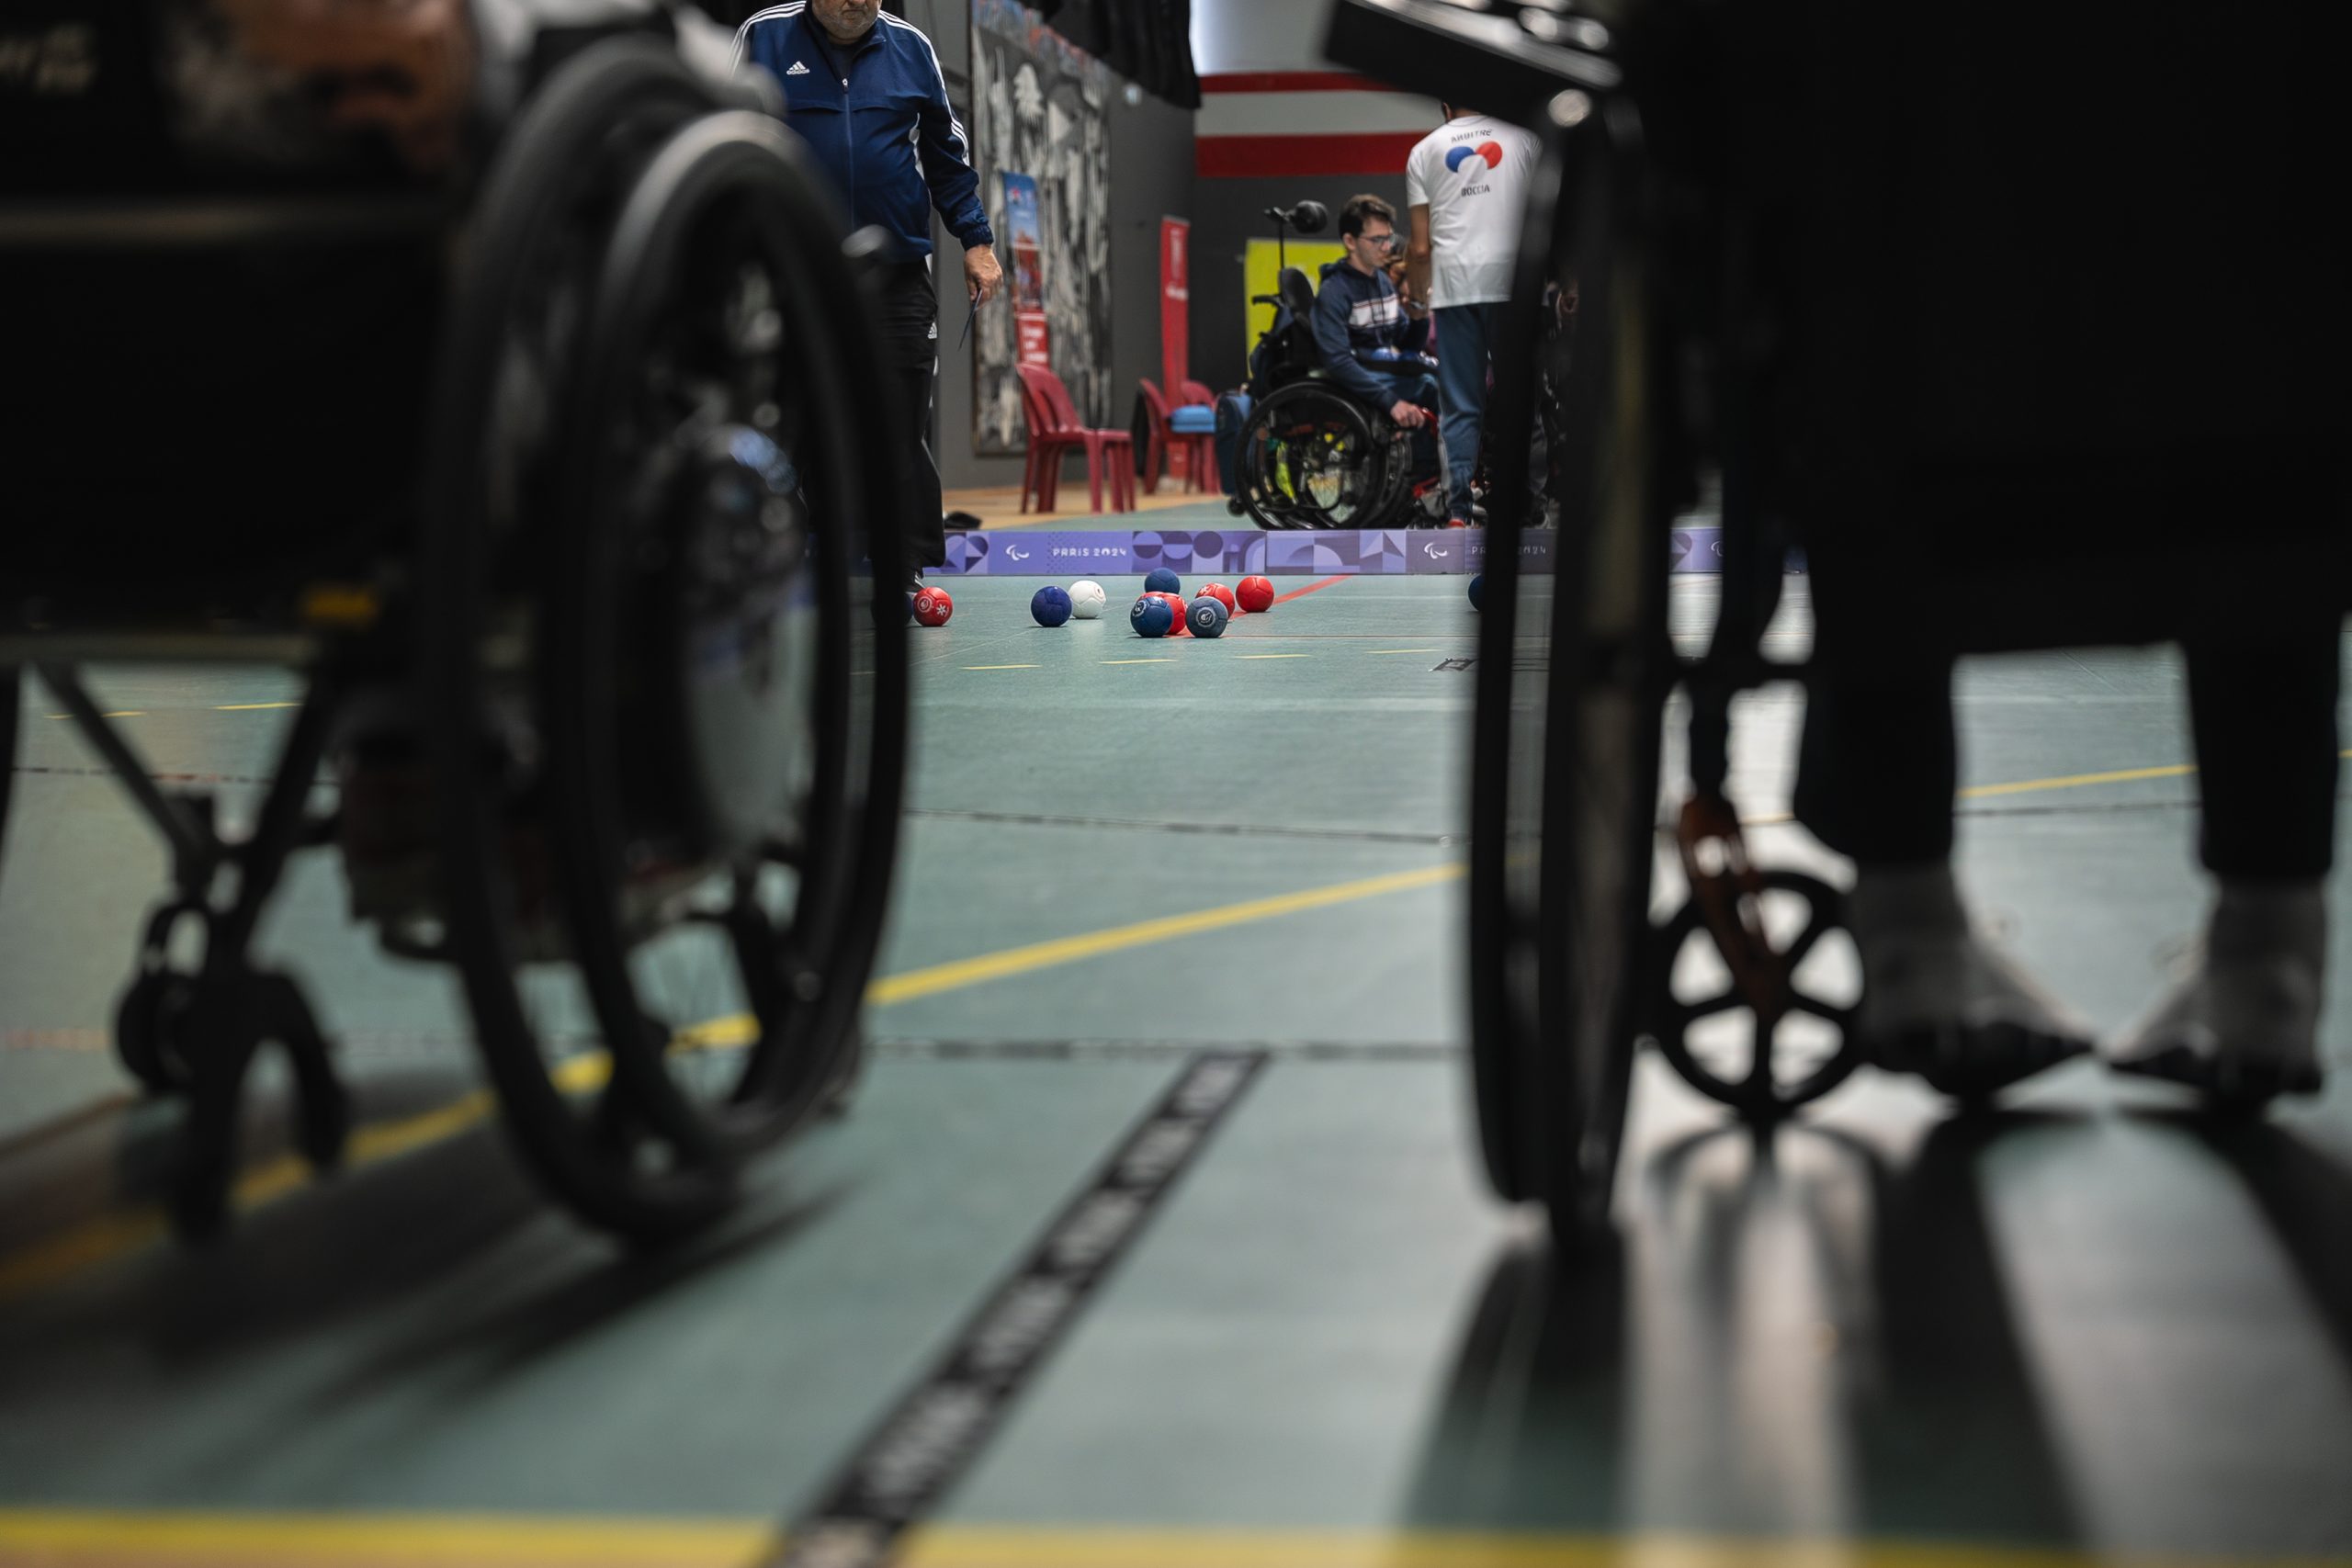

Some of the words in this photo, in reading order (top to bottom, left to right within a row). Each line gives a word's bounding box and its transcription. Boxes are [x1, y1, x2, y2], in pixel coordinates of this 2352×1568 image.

[1461, 184, 1490, 197] BOCCIA
[1053, 547, 1090, 557] PARIS
[1093, 547, 1126, 557] 2024
[1520, 546, 1546, 555] 024
